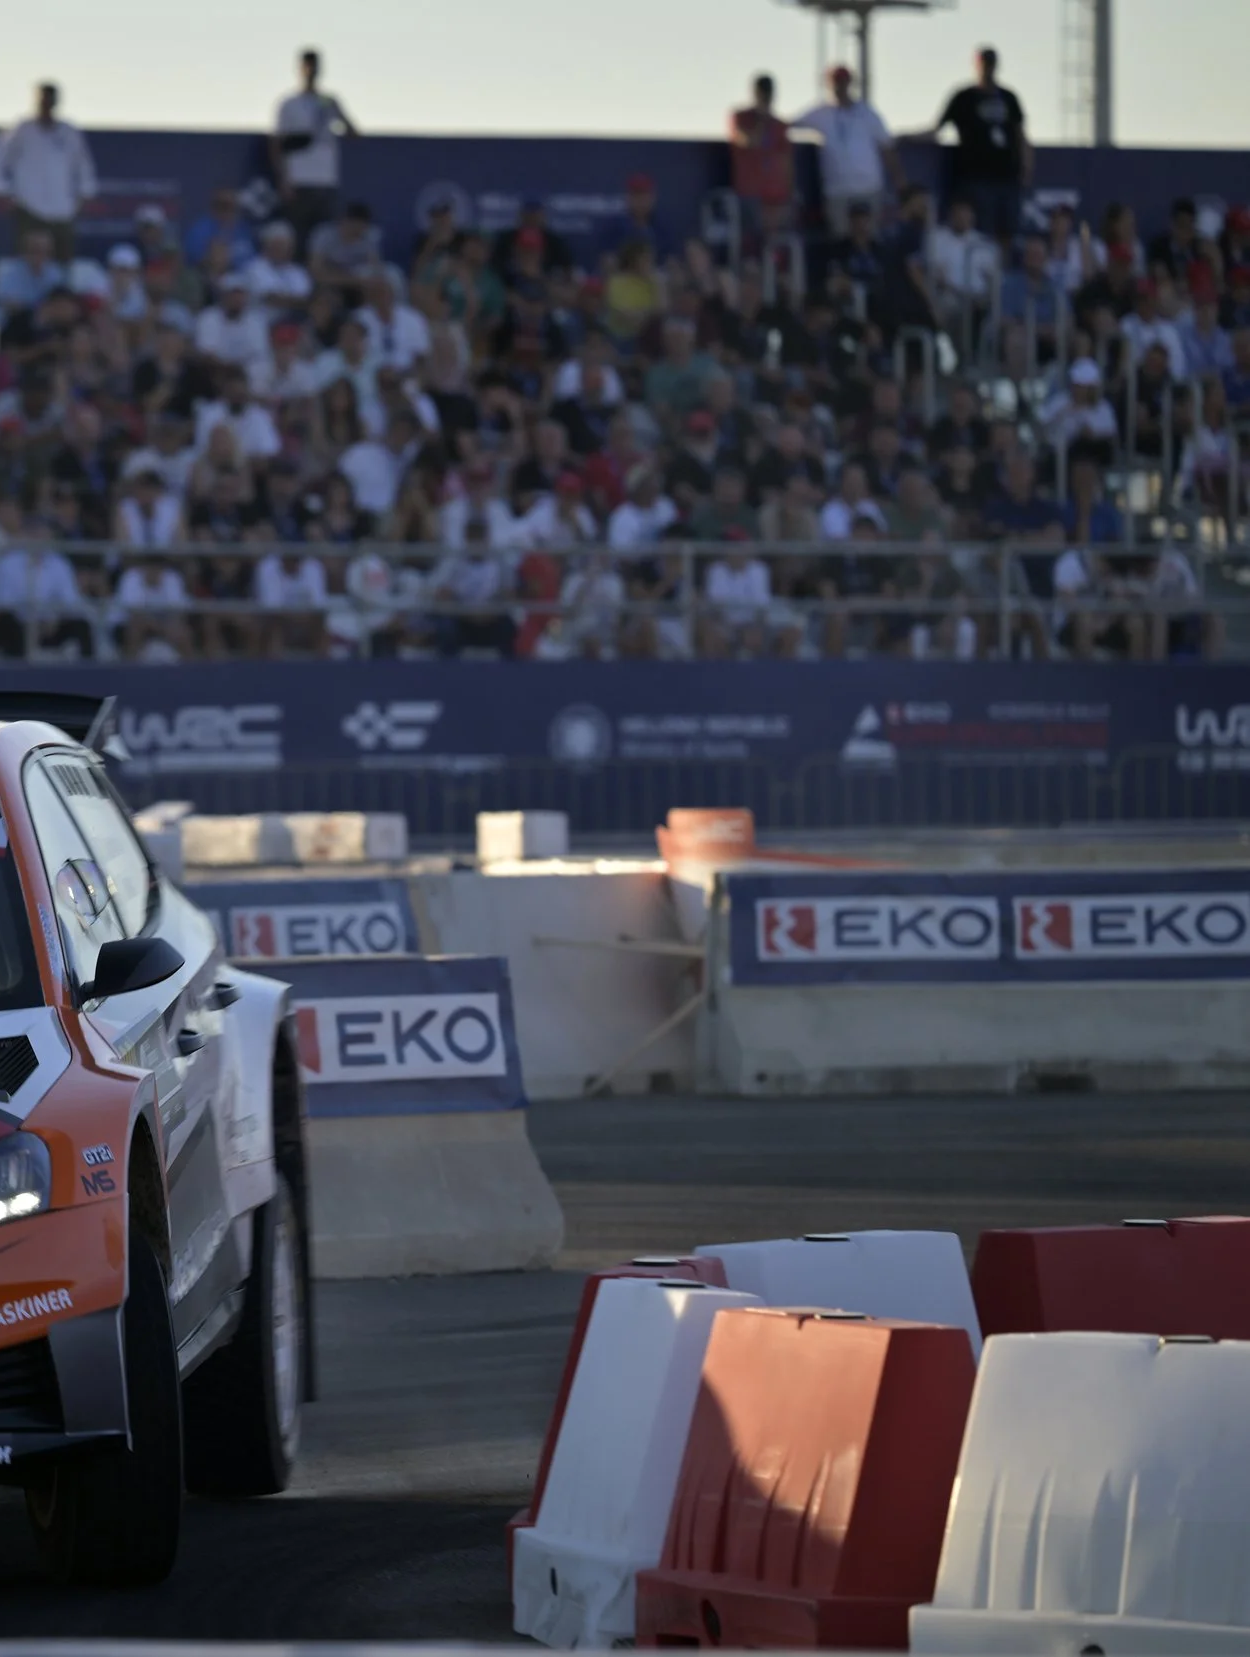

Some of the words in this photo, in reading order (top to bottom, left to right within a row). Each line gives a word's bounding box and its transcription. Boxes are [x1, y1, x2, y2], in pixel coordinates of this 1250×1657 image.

[120, 704, 280, 750] WRC
[287, 911, 399, 954] EKO
[833, 907, 993, 949] EKO
[1089, 903, 1248, 945] EKO
[336, 1006, 496, 1068] EKO
[80, 1169, 116, 1196] MS
